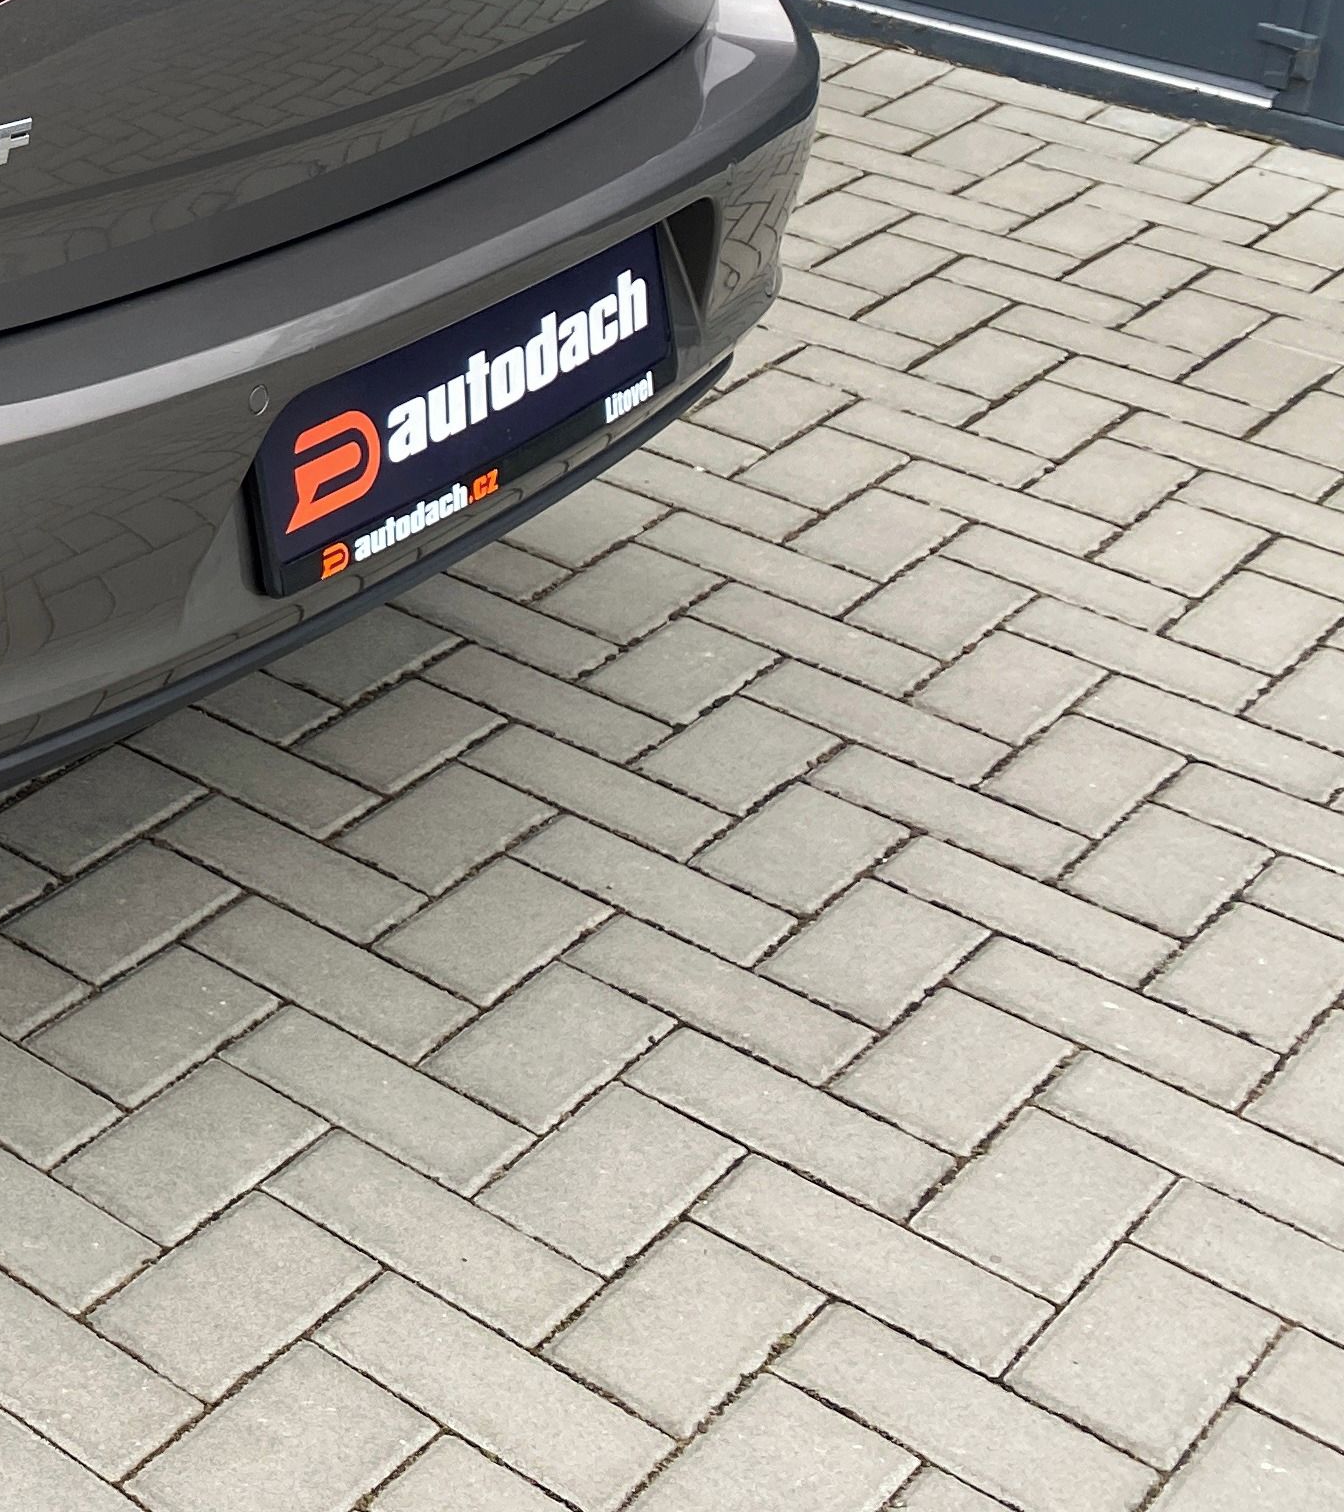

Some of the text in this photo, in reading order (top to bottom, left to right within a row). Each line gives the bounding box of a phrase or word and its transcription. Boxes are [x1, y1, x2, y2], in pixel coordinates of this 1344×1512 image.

[387, 269, 649, 464] autodach
[604, 371, 654, 424] Litovel
[354, 468, 500, 562] autodach.cz
